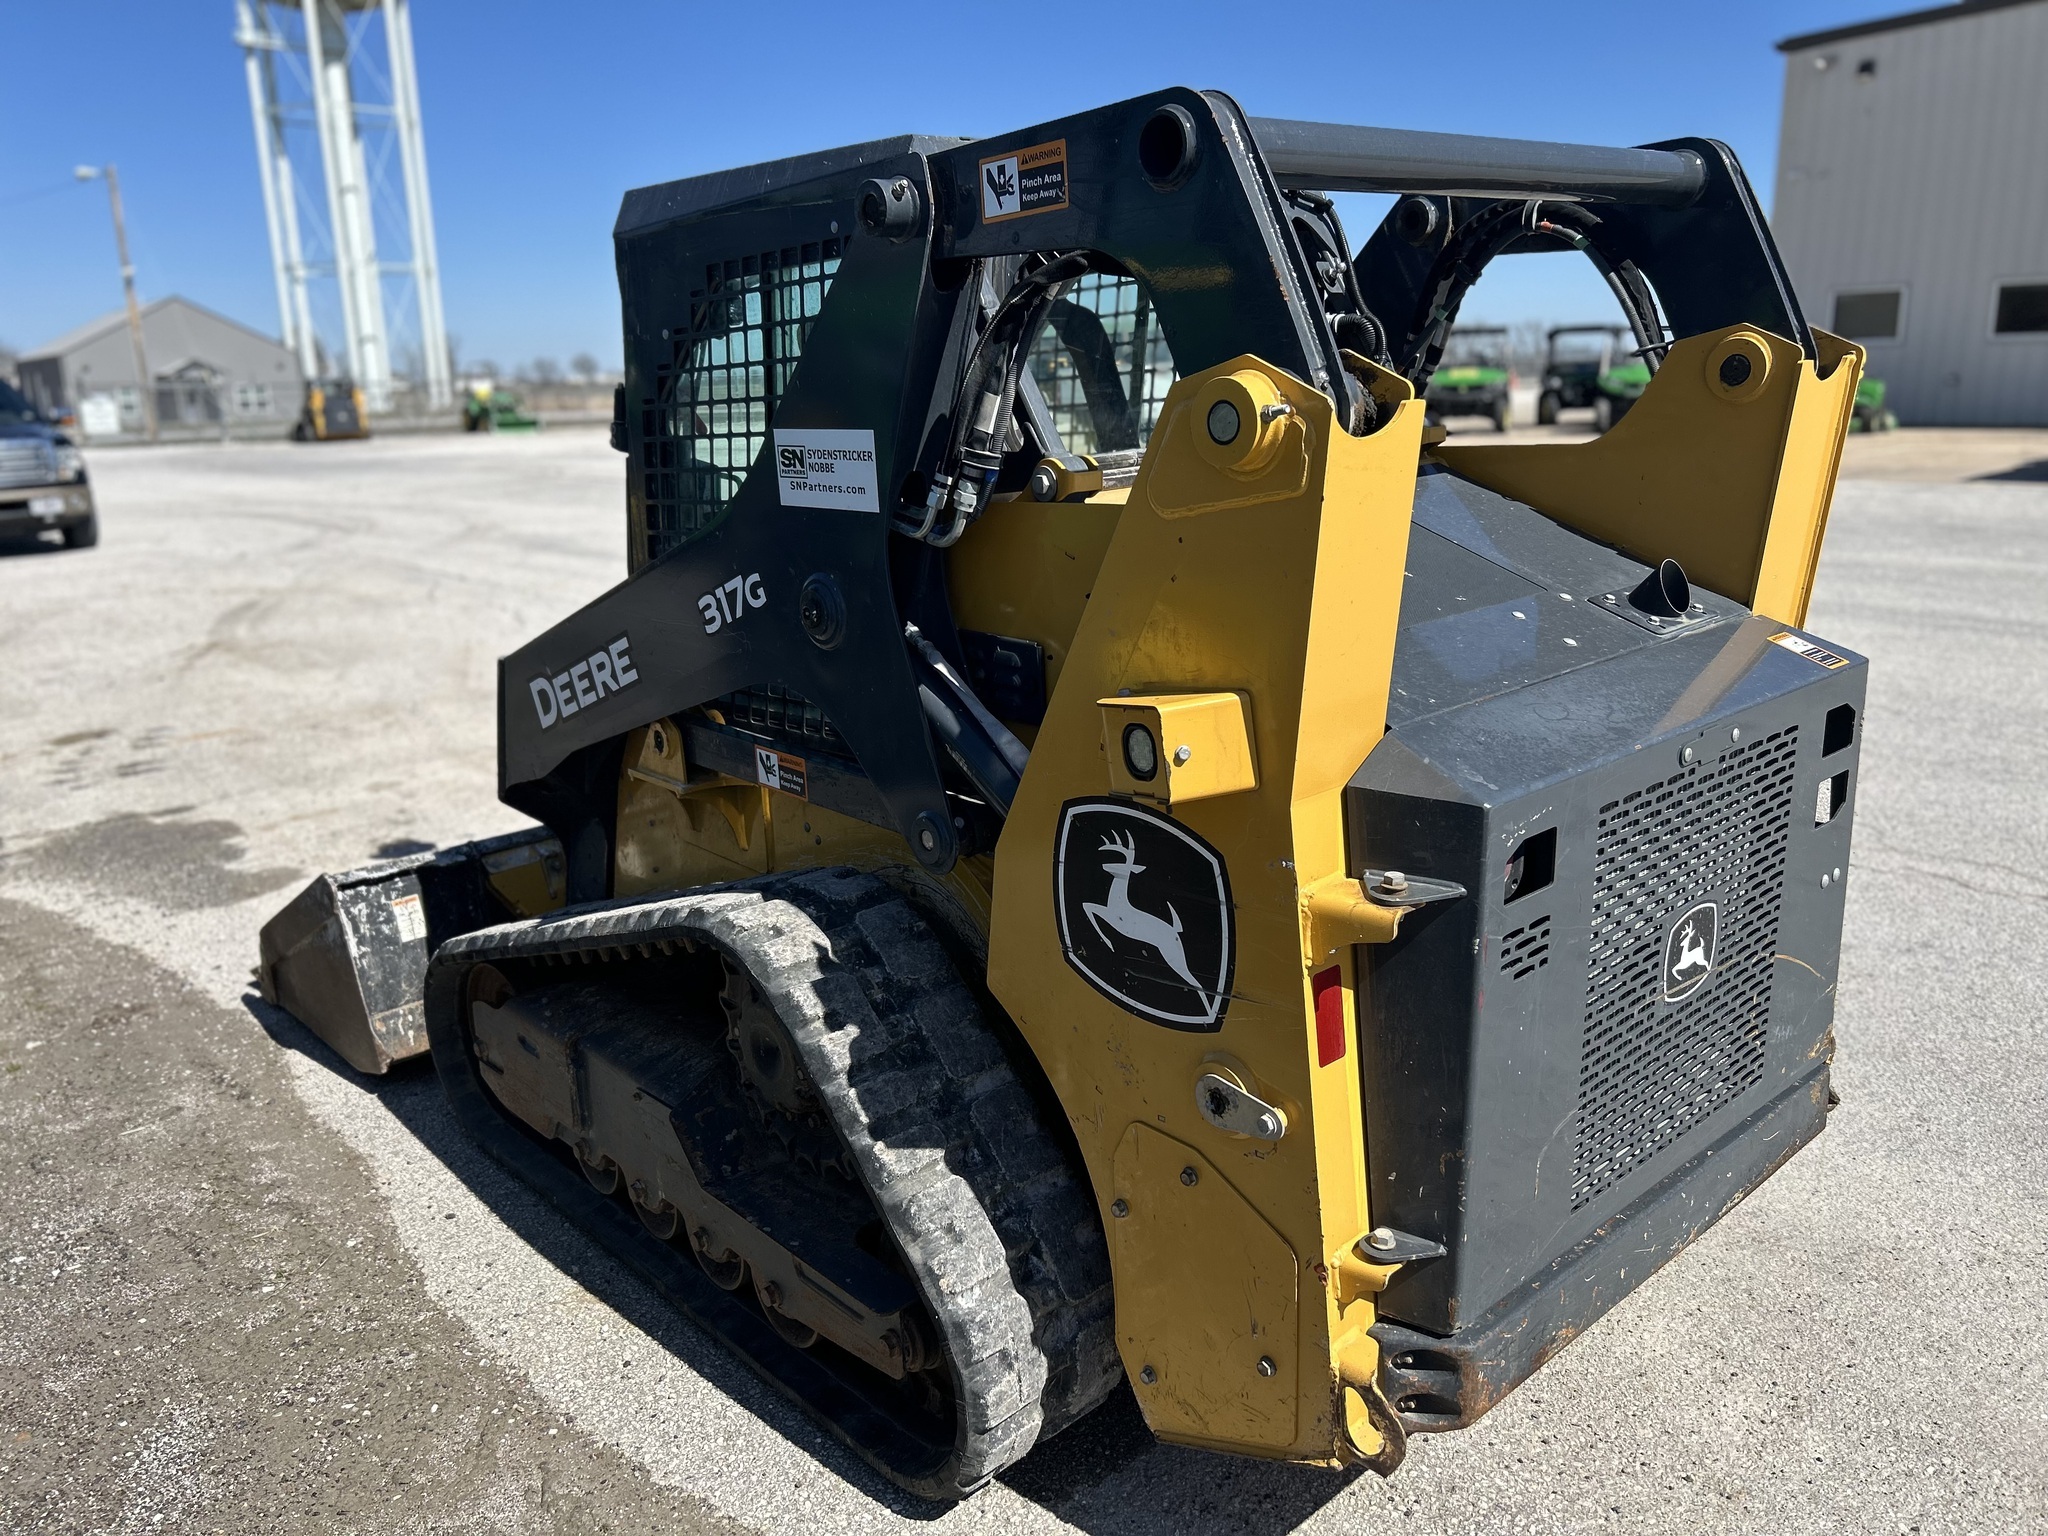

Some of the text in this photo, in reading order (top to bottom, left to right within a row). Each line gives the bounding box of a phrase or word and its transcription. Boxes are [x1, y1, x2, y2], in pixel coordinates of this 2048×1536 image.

[1027, 147, 1061, 163] WARNING
[1021, 173, 1062, 189] Pinch Area
[1022, 188, 1057, 202] Keep Away
[807, 449, 873, 462] SYDENSTRICKER
[808, 462, 835, 473] NOBBE
[790, 480, 866, 495] SNPartners.com
[698, 573, 767, 634] 317G
[529, 636, 639, 729] DEERE
